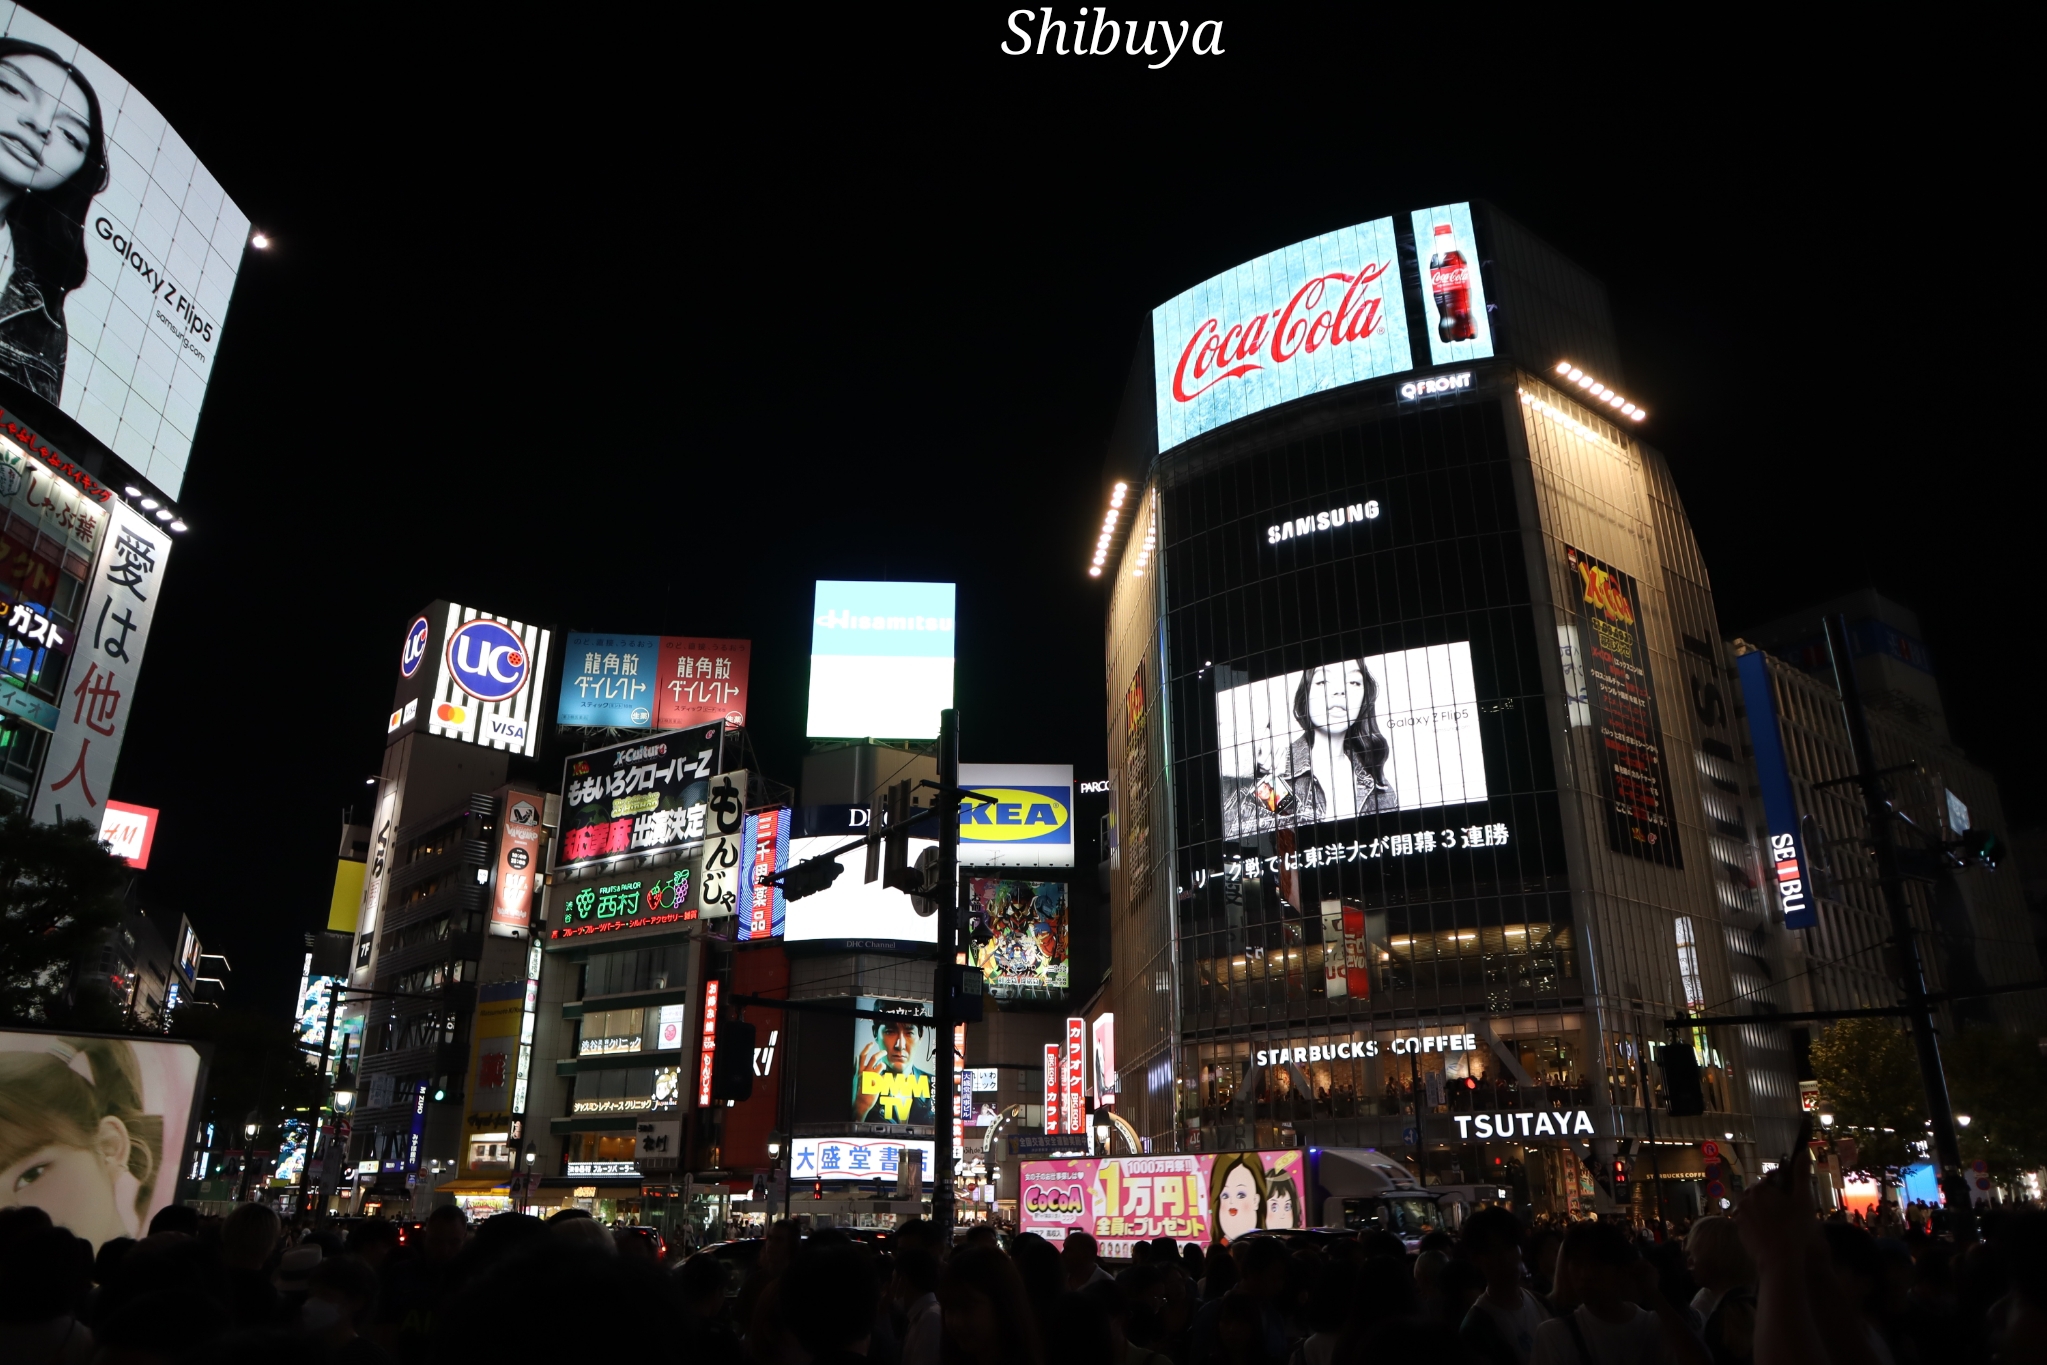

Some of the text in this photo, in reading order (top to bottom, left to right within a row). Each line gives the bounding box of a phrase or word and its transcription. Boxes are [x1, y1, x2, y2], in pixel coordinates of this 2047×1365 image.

[95, 217, 213, 342] Galaxy Z Flip5
[1431, 268, 1470, 285] Coca-Cola
[156, 309, 206, 363] samsung.com
[1172, 259, 1391, 402] Coca-Cola
[1401, 372, 1471, 399] QFRONT
[27, 477, 97, 543] しゃぶ葉
[1268, 500, 1380, 544] SAMSUNG
[8, 602, 64, 648] ガスト
[816, 609, 953, 631] Hisamitsu
[404, 629, 426, 665] UC
[457, 634, 519, 683] UC
[51, 525, 156, 825] 愛は他人
[584, 652, 640, 676] 龍角散
[677, 656, 732, 680] 龍角散
[574, 676, 646, 700] ダイレクト
[668, 680, 739, 704] ダイレクト
[492, 721, 524, 739] VISA
[1386, 709, 1469, 731] Galaxy Z Flip5
[568, 749, 713, 806] ももいろクローバーZ
[631, 804, 707, 849] 出演決定
[958, 803, 1059, 825] KEA
[102, 822, 138, 844] H&M
[703, 777, 742, 912] もんじゃ
[1771, 833, 1805, 915] SEIBU
[597, 891, 640, 919] 西村
[361, 942, 371, 957] 7F
[865, 941, 896, 949] Channel
[1257, 1033, 1476, 1067] STARBUCKS COFFEE
[862, 1071, 931, 1099] DMM
[1069, 1027, 1082, 1131] カラオケ BIG ECHO
[417, 1086, 426, 1114] MZUHO
[880, 1097, 913, 1121] TV
[1047, 1093, 1058, 1132] カラオ
[1454, 1110, 1594, 1139] TSUTAYA
[1099, 1161, 1199, 1216] 1万円!
[1096, 1216, 1205, 1237] 全員にプレゼント
